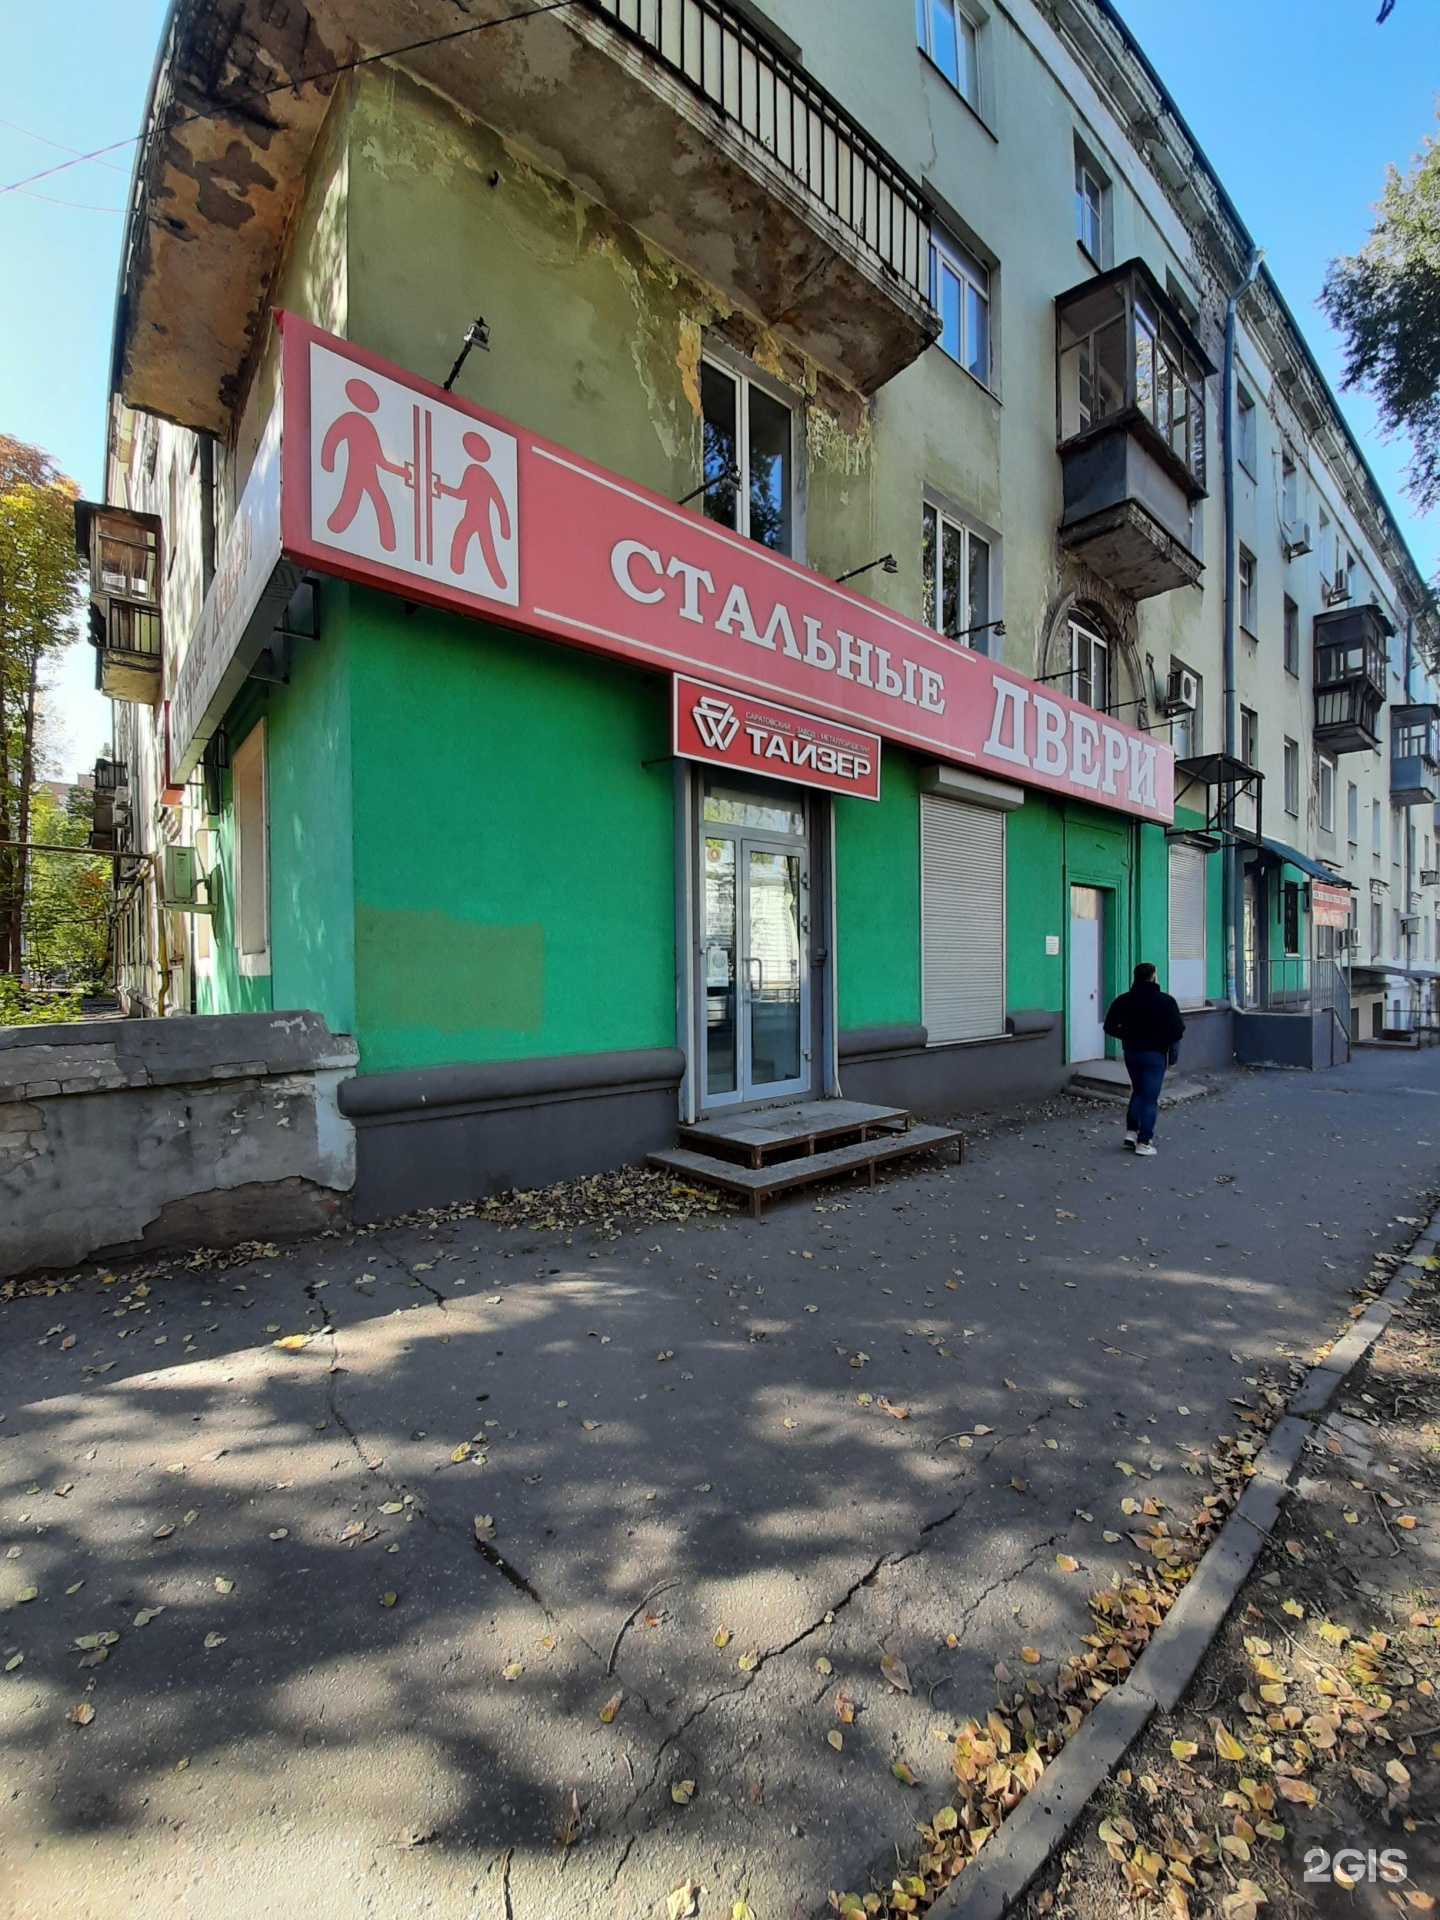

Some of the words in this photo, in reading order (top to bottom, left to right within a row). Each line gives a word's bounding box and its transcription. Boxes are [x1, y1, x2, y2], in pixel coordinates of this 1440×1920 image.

[610, 539, 947, 715] СТАЛЬНЫЕ
[983, 675, 1158, 808] ДВЕРИ
[745, 727, 872, 780] ТАЙЗЕР
